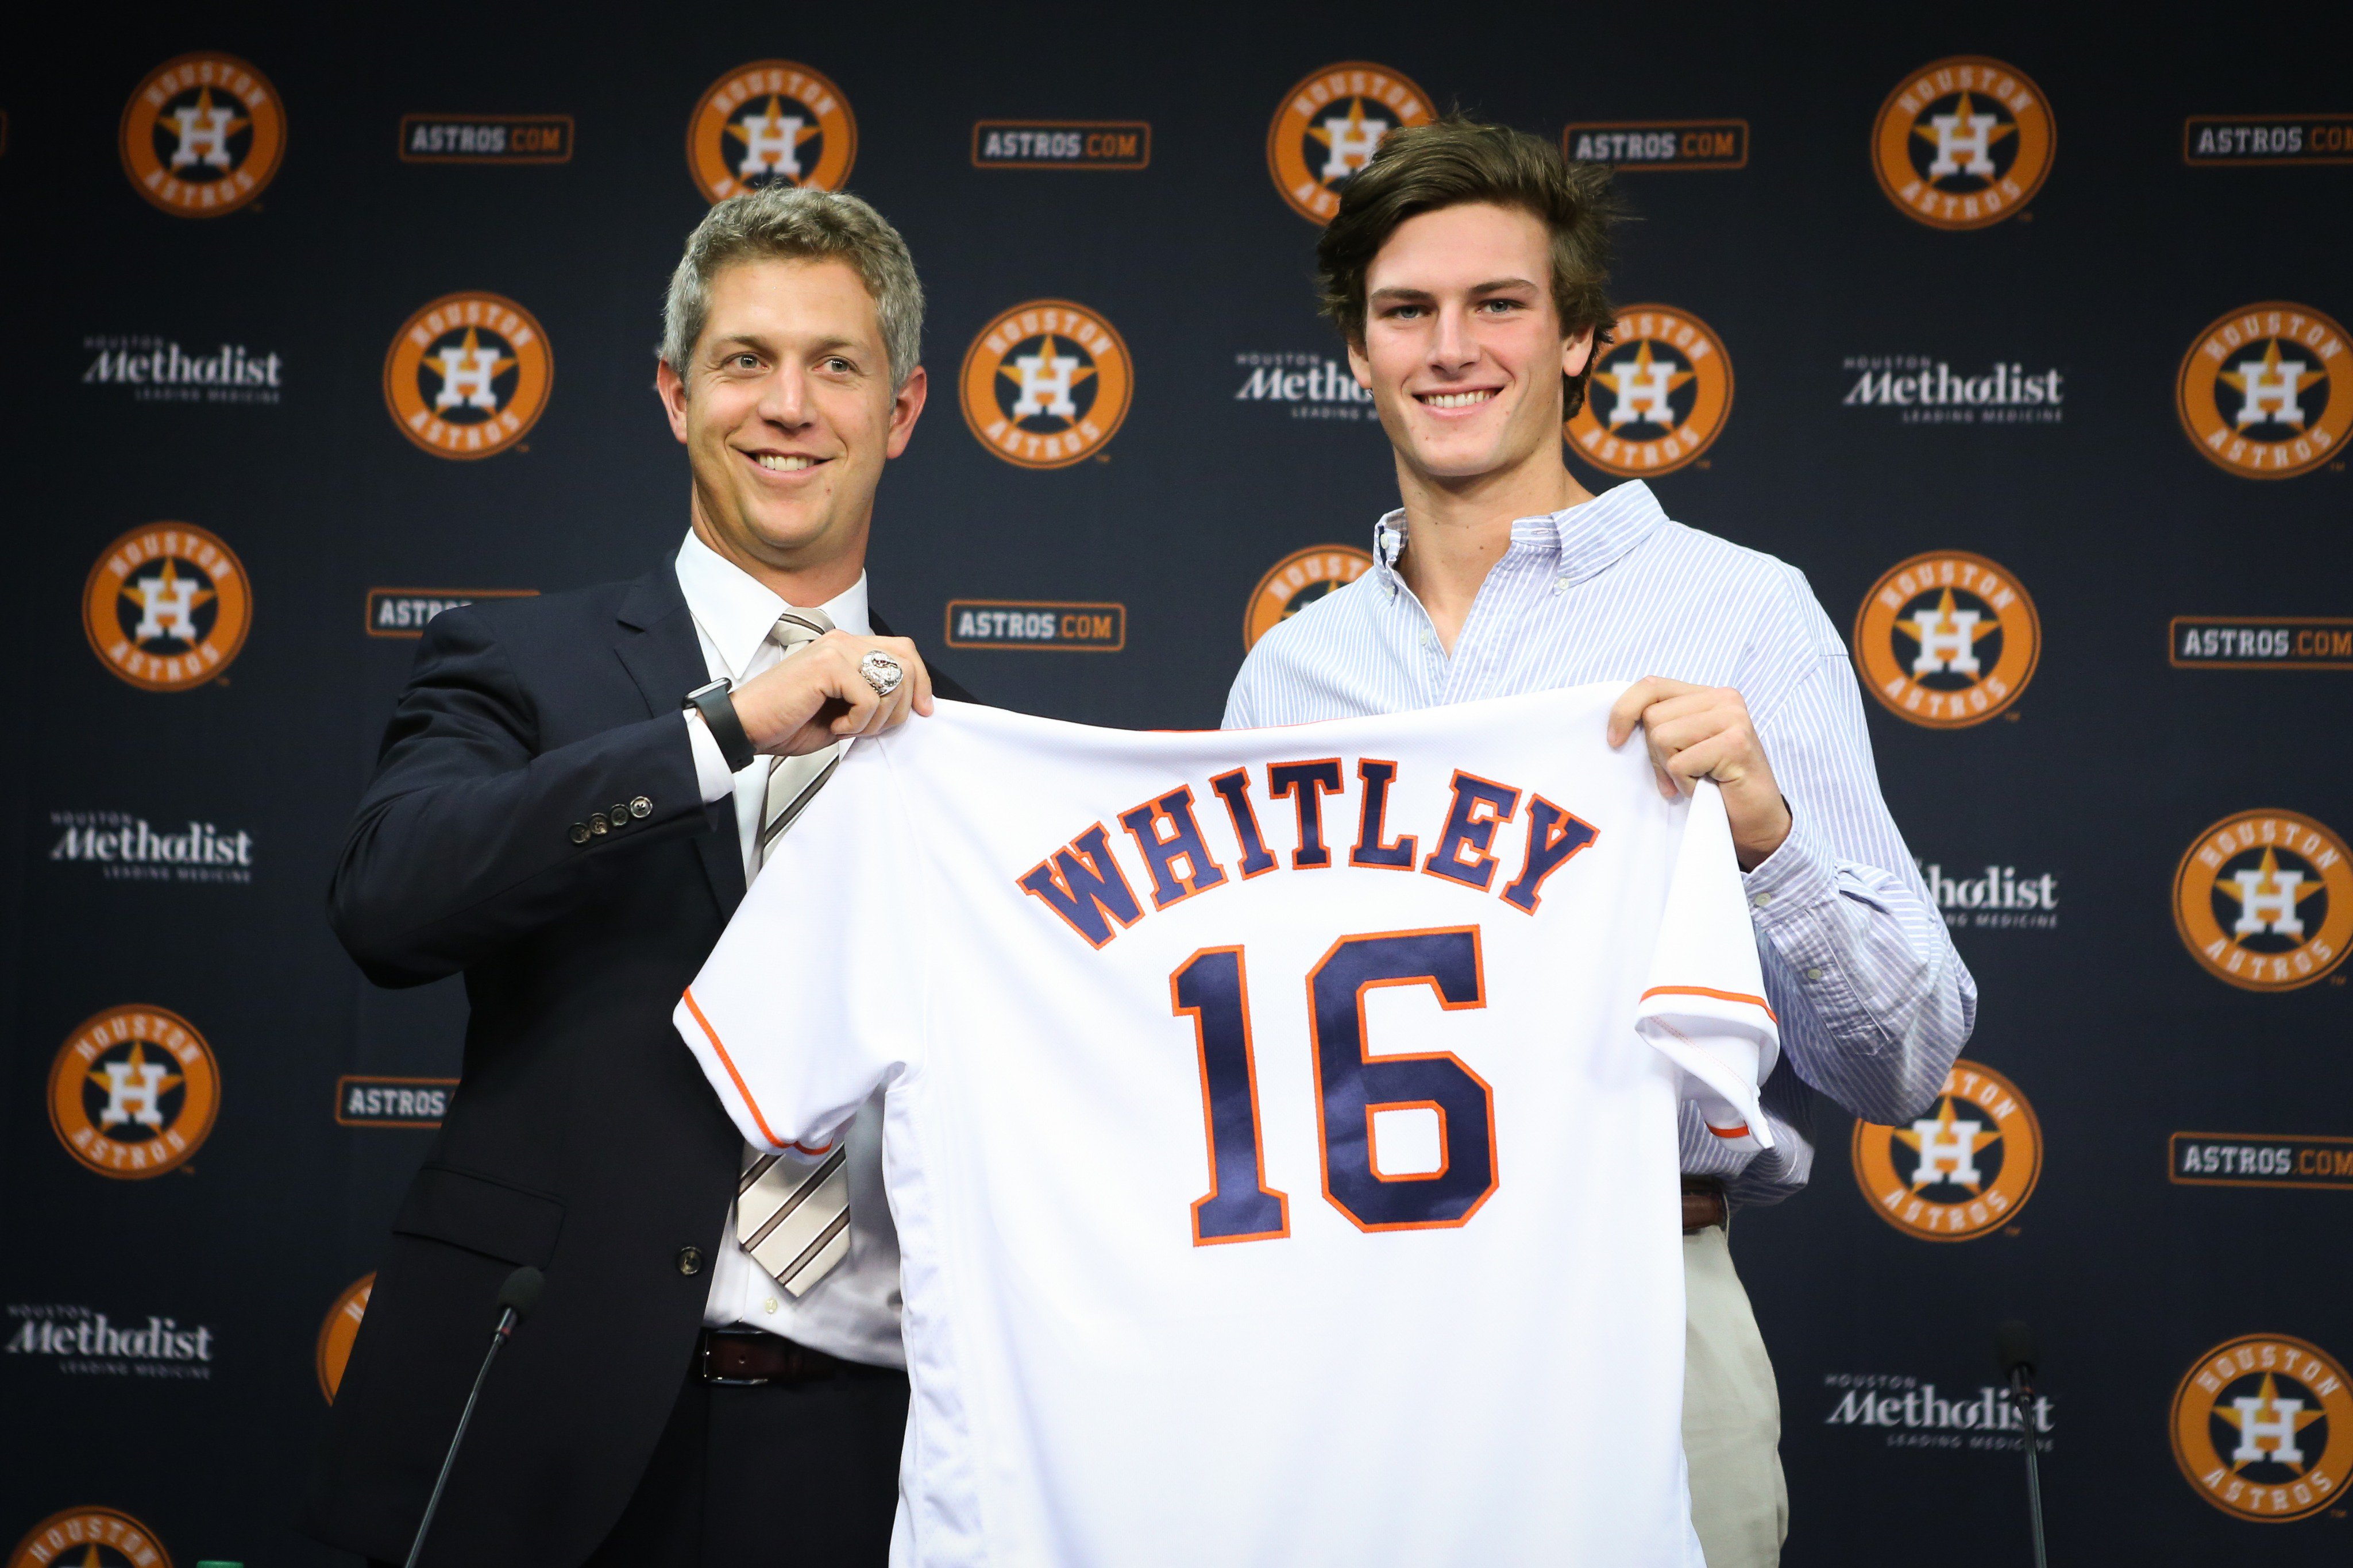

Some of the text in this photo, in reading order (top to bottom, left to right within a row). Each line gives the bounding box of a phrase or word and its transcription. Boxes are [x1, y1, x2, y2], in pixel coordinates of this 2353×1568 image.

[145, 63, 266, 107] HOUSTON
[713, 71, 836, 113] HOUSTON
[1293, 73, 1419, 117] HOUSTON
[1898, 67, 2032, 113] HOUSTON
[172, 108, 233, 165] H
[412, 125, 560, 152] ASTROS.COM
[740, 116, 803, 173] H
[985, 132, 1136, 157] ASTROS.COM
[1322, 118, 1387, 176] H
[1576, 132, 1733, 159] ASTROS.COM
[1930, 115, 1996, 175] H
[146, 170, 253, 207] ASTROS
[1901, 179, 2020, 219] ASTROS
[411, 302, 534, 346] HOUSTON
[986, 310, 1113, 354] HOUSTON
[1617, 314, 1711, 360] USTON
[2204, 313, 2342, 360] HOUSTON
[83, 343, 281, 385] Methodist
[437, 347, 500, 407] H
[1014, 356, 1078, 416] H
[1236, 362, 1373, 400] Metho
[1843, 363, 2062, 404] Methodist
[1610, 362, 1676, 423] H
[2237, 362, 2305, 423] H
[410, 411, 520, 449] ASTROS
[986, 420, 1100, 459] ASTROS
[1581, 426, 1699, 467] ASTROS
[2207, 427, 2331, 468] ASTROS
[110, 532, 232, 577] HOUSTON
[1270, 556, 1364, 600] HOUST
[1880, 561, 2015, 609] HOUSTON
[136, 579, 199, 639] H
[958, 611, 1112, 638] ASTROS.COM
[111, 642, 219, 681] ASTROS
[1913, 611, 1980, 673] H
[1885, 677, 2007, 717] ASTROS
[52, 820, 252, 865] Methodist
[1016, 757, 1600, 951] WHITLEY
[2198, 820, 2339, 867] HOUSTON
[1929, 864, 2058, 911] hodist
[2234, 871, 2303, 933] H
[2205, 939, 2332, 980] ASTROS
[76, 1016, 200, 1063] HOUSTON
[101, 1063, 167, 1124] H
[1170, 924, 1500, 1248] 16
[74, 1128, 186, 1168] ASTROS
[1912, 1120, 1980, 1184] H
[1883, 1188, 2008, 1230] ASTROS
[6, 1313, 213, 1360] Methodist
[2196, 1345, 2340, 1395] HOUSTON
[2233, 1397, 2302, 1463] H
[2203, 1469, 2332, 1511] ASTROS
[30, 1517, 157, 1565] HOUSTON
